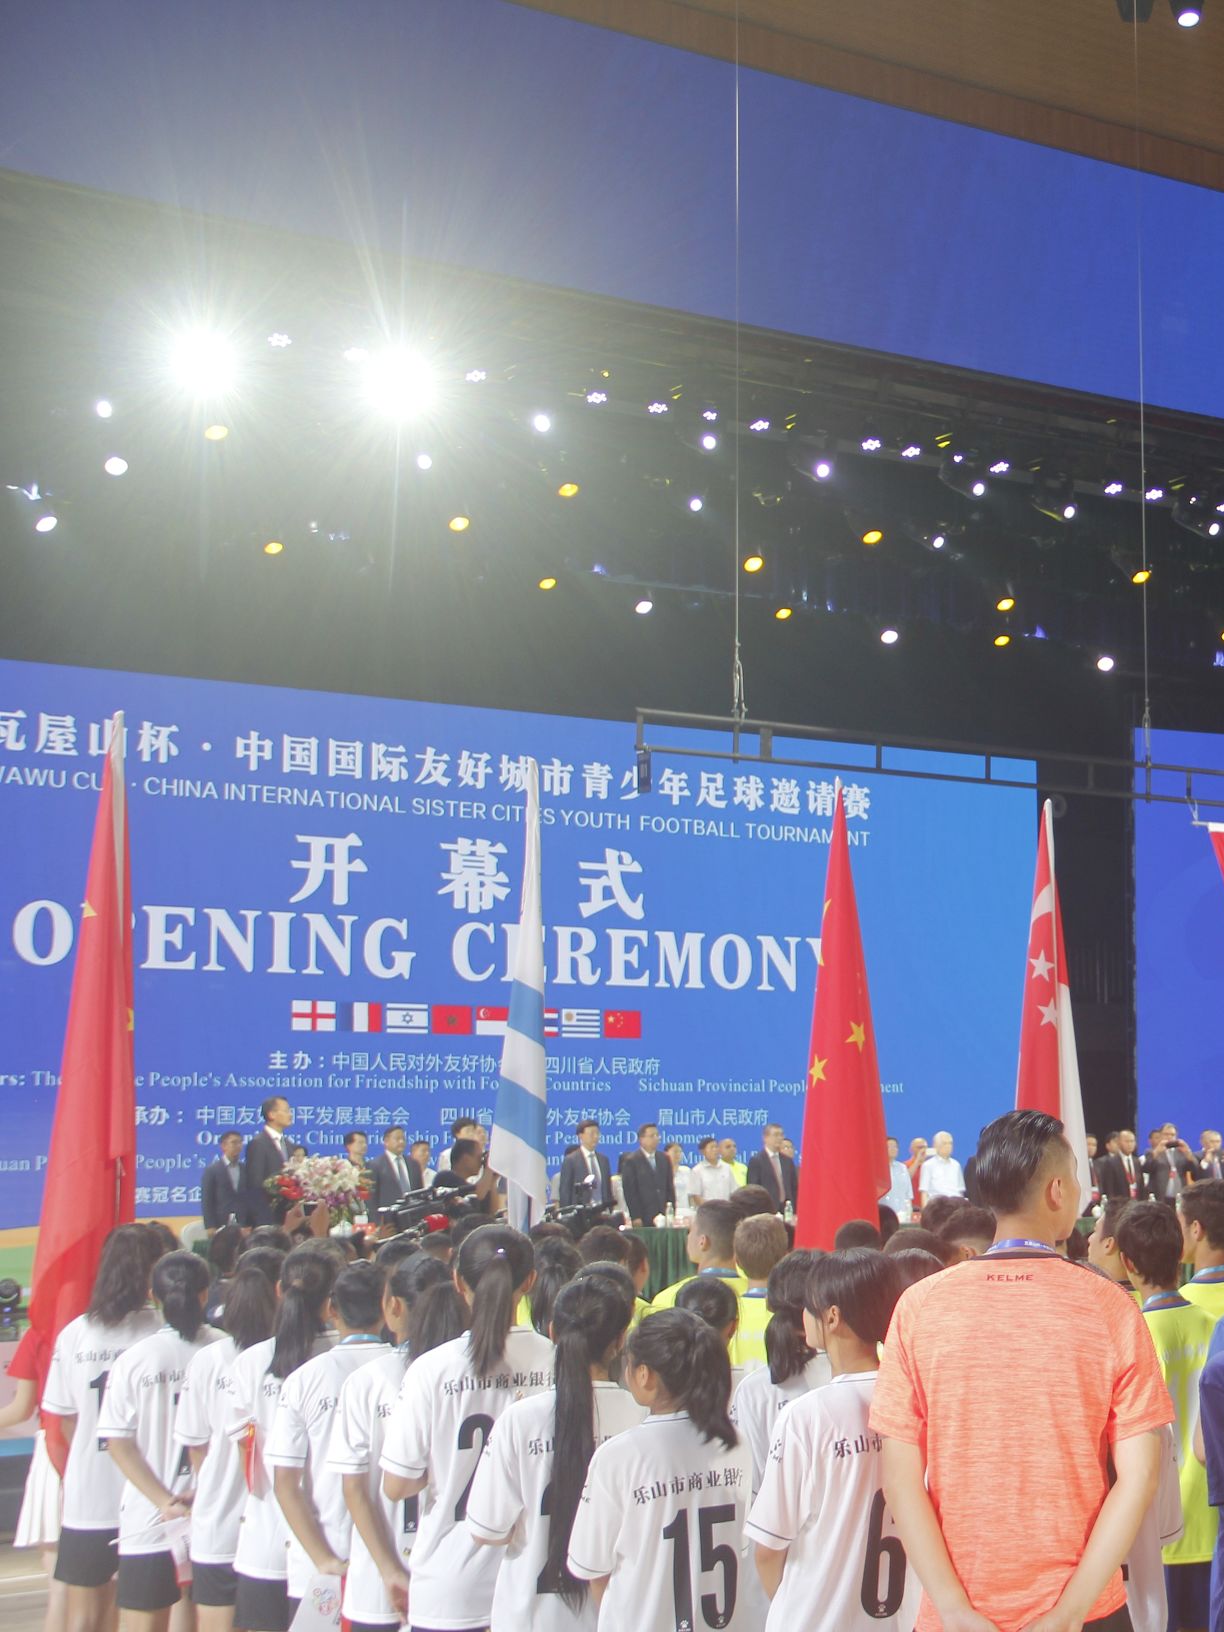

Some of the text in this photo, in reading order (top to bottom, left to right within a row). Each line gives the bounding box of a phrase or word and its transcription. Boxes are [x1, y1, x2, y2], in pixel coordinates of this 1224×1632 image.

[143, 776, 218, 800] CHINA
[224, 782, 406, 815] INTERNATIONAL
[412, 797, 487, 821] SISTER
[492, 803, 556, 827] CITS
[560, 809, 631, 831] YOUTH
[639, 815, 741, 840] FOOTBALL
[745, 822, 871, 848] TOURNAMNT
[12, 899, 417, 981] OENING
[149, 1071, 221, 1092] People's
[225, 1072, 323, 1089] Association
[327, 1074, 351, 1089] for
[355, 1074, 440, 1094] Friendship
[443, 1075, 476, 1090] with
[638, 1077, 693, 1092] Sichuan
[697, 1078, 766, 1093] Provincial
[769, 1079, 809, 1097] Peopl
[268, 1050, 661, 1076] 主办：中国人民对外友好协 四川省人民政府
[306, 1130, 345, 1146] Chin
[658, 1108, 769, 1126] 眉山市人民政府
[662, 1503, 739, 1632] 15
[860, 1487, 908, 1619] 6
